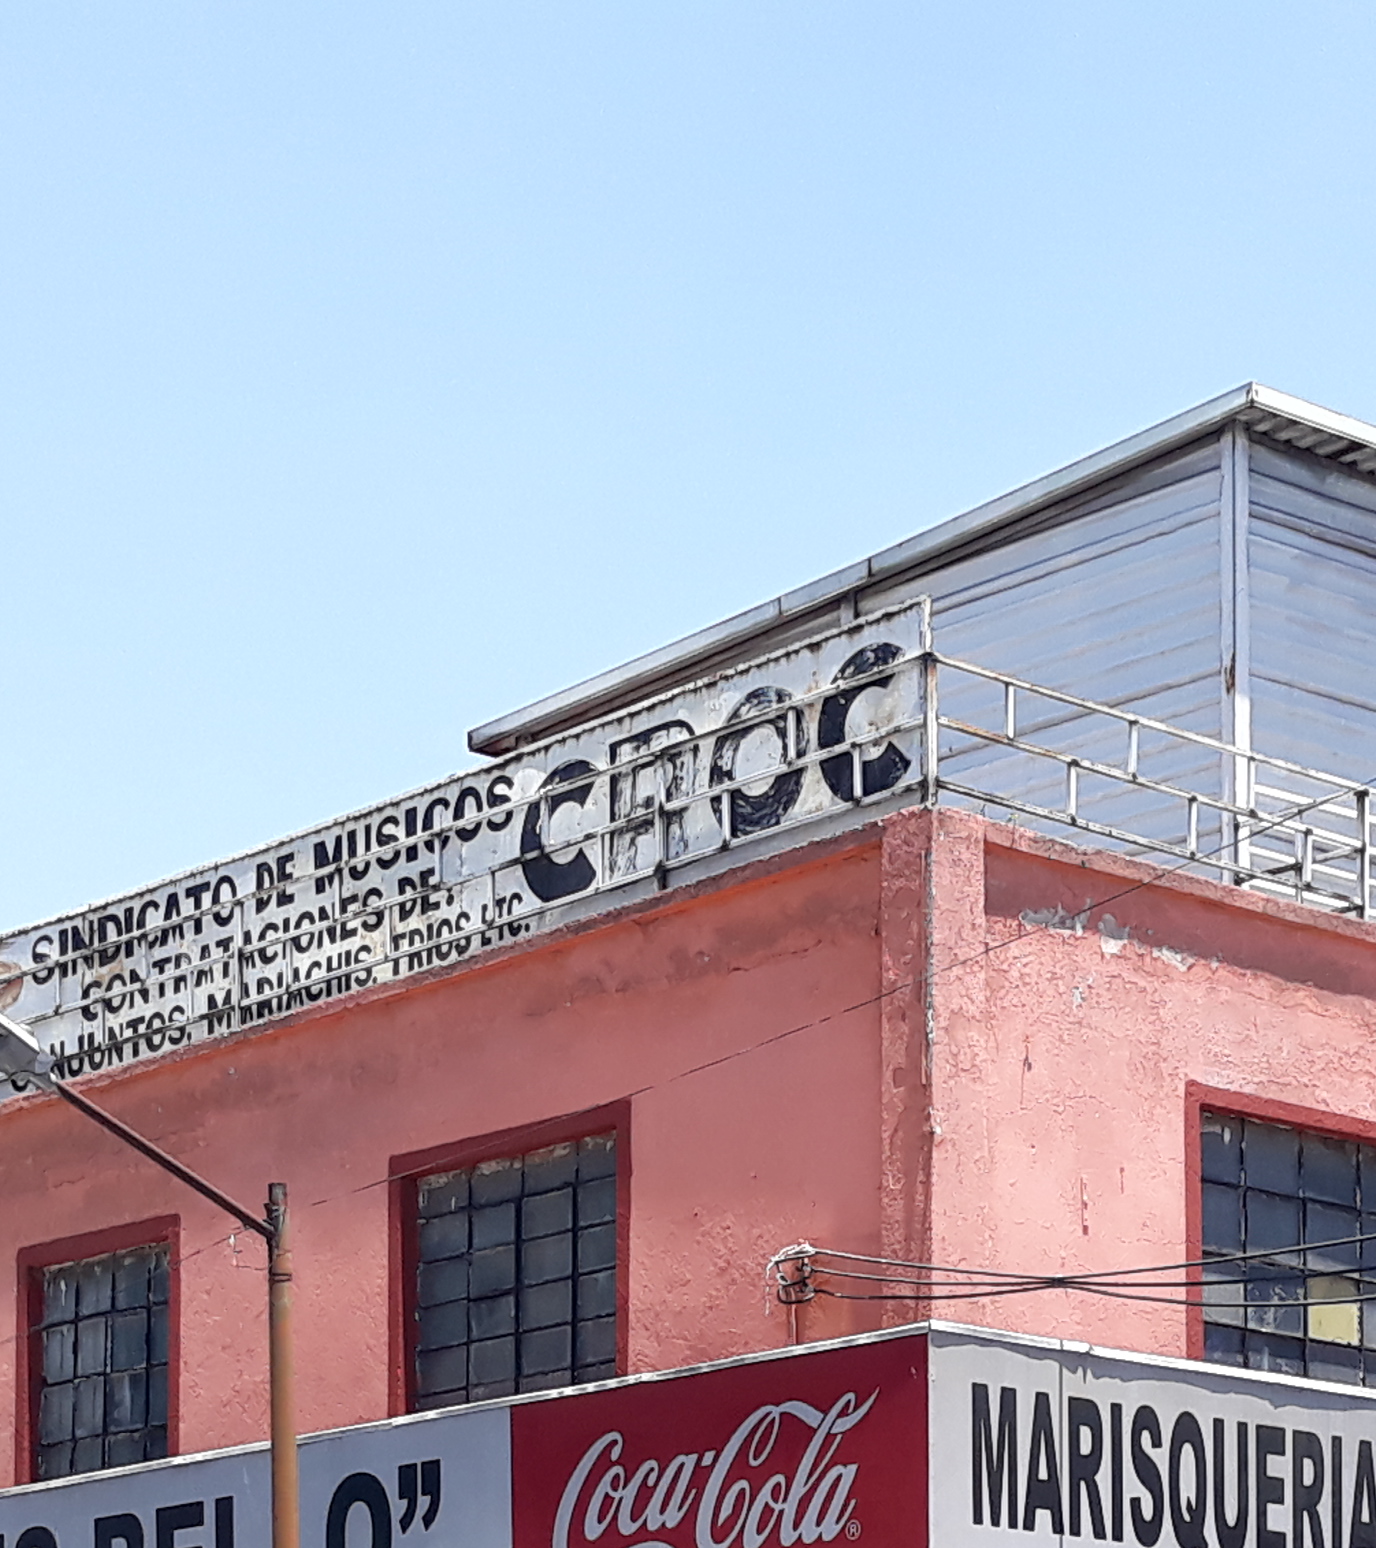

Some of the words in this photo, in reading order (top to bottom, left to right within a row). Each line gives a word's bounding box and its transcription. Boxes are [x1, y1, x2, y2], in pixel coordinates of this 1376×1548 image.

[31, 875, 237, 986] SINDICATO
[255, 853, 295, 915] DE
[314, 775, 514, 895] MUSICOS
[80, 886, 385, 1021] CONTRATACIONES
